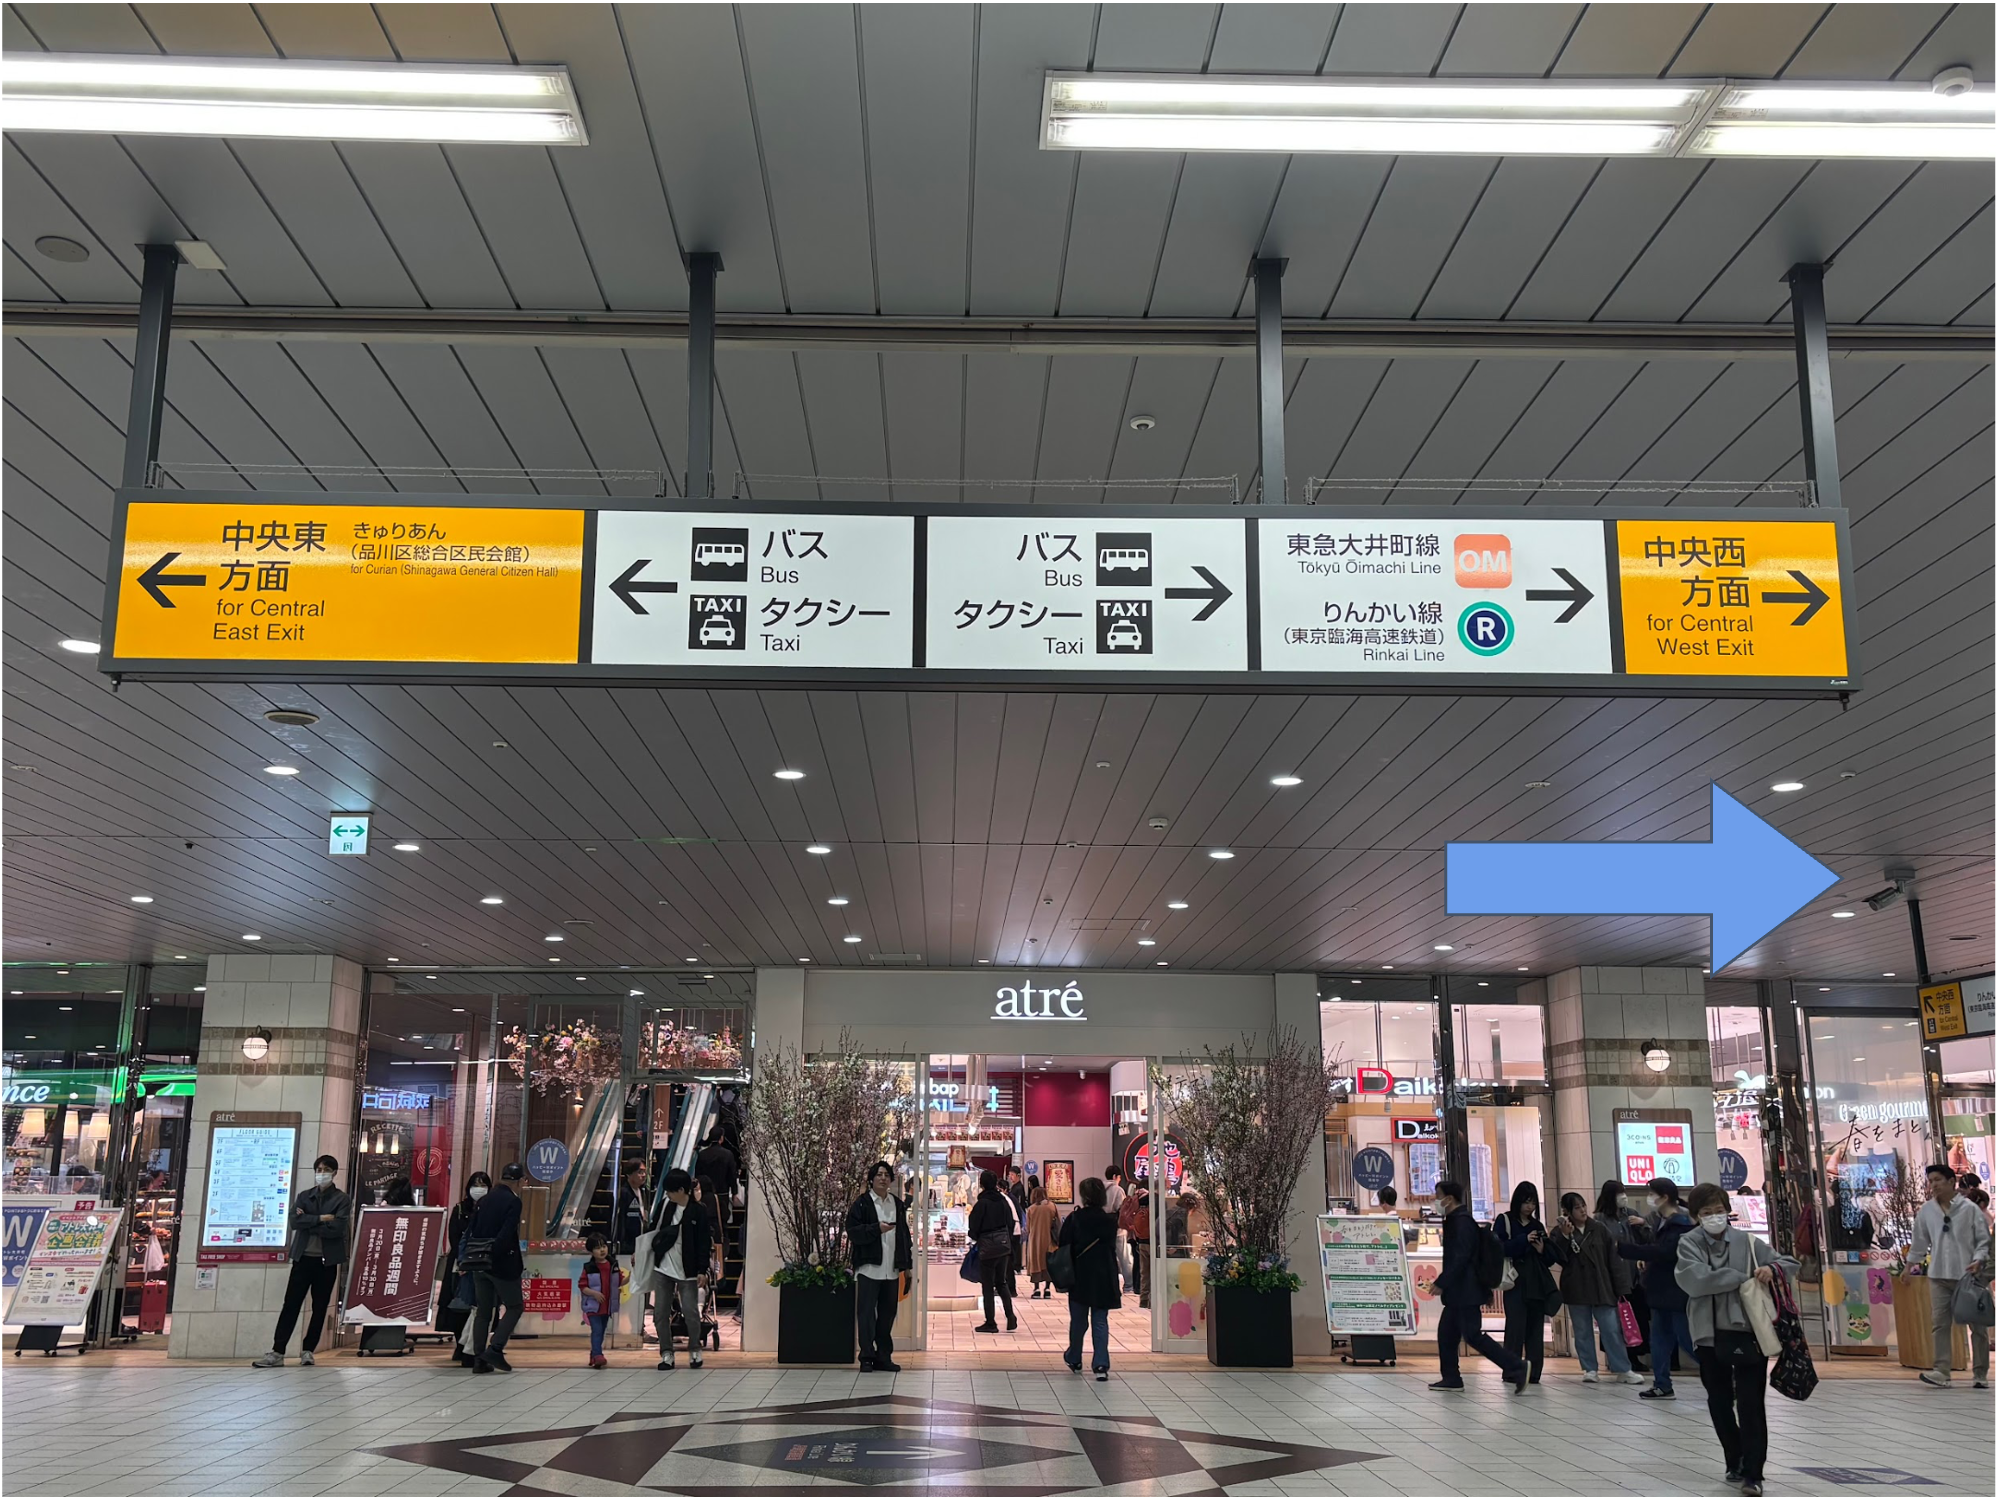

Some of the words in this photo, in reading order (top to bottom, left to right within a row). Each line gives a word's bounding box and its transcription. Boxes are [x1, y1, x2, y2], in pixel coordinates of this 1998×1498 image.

[222, 520, 328, 553] 中央東
[353, 521, 447, 541] きゅりあん
[761, 529, 829, 560] バス
[1017, 532, 1083, 563] バス
[1286, 533, 1441, 557] 東急大井町線
[1644, 535, 1746, 568] 中央西
[1297, 560, 1340, 576] Tōkyū
[1345, 558, 1406, 574] Ōimachi
[1410, 561, 1442, 574] Line
[1459, 549, 1508, 573] OM
[219, 559, 291, 592] 方面
[351, 564, 363, 575] for
[366, 564, 398, 575] Curian
[400, 565, 457, 578] (Shinagawa
[460, 565, 498, 577] General
[501, 566, 533, 576] Citizen
[536, 567, 559, 578] Hall)
[761, 566, 799, 584] Bus
[1045, 569, 1083, 587] Bus
[1681, 575, 1750, 608] 方面
[217, 599, 244, 616] for
[250, 599, 325, 617] Central
[694, 596, 742, 613] TAXI
[761, 596, 891, 628] タクシー
[1100, 602, 1148, 617] TAXI
[1324, 601, 1443, 625] りんかい線
[954, 600, 1083, 630] タクシー
[1646, 613, 1674, 631] for
[1680, 613, 1754, 632] Central
[213, 623, 259, 641] East
[266, 624, 305, 641] Exit
[1477, 616, 1496, 641] R
[760, 634, 800, 652] Taxi
[1043, 637, 1083, 655] Taxi
[1656, 637, 1709, 656] West
[1717, 638, 1755, 656] Exit
[1363, 648, 1409, 661] Rinkai
[1414, 649, 1445, 661] Line
[995, 979, 1084, 1017] atré
[1936, 988, 1955, 1002] 中央西
[1938, 1003, 1951, 1015] 方面
[215, 1113, 235, 1122] atré
[1619, 1109, 1640, 1119] atré
[653, 1121, 664, 1130] 2F
[540, 1146, 559, 1165] W
[1363, 1155, 1383, 1174] W
[1628, 1158, 1651, 1170] UNI
[1630, 1170, 1653, 1184] QLO
[77, 1202, 93, 1210] 予告
[383, 1216, 410, 1296] 無印良品週間
